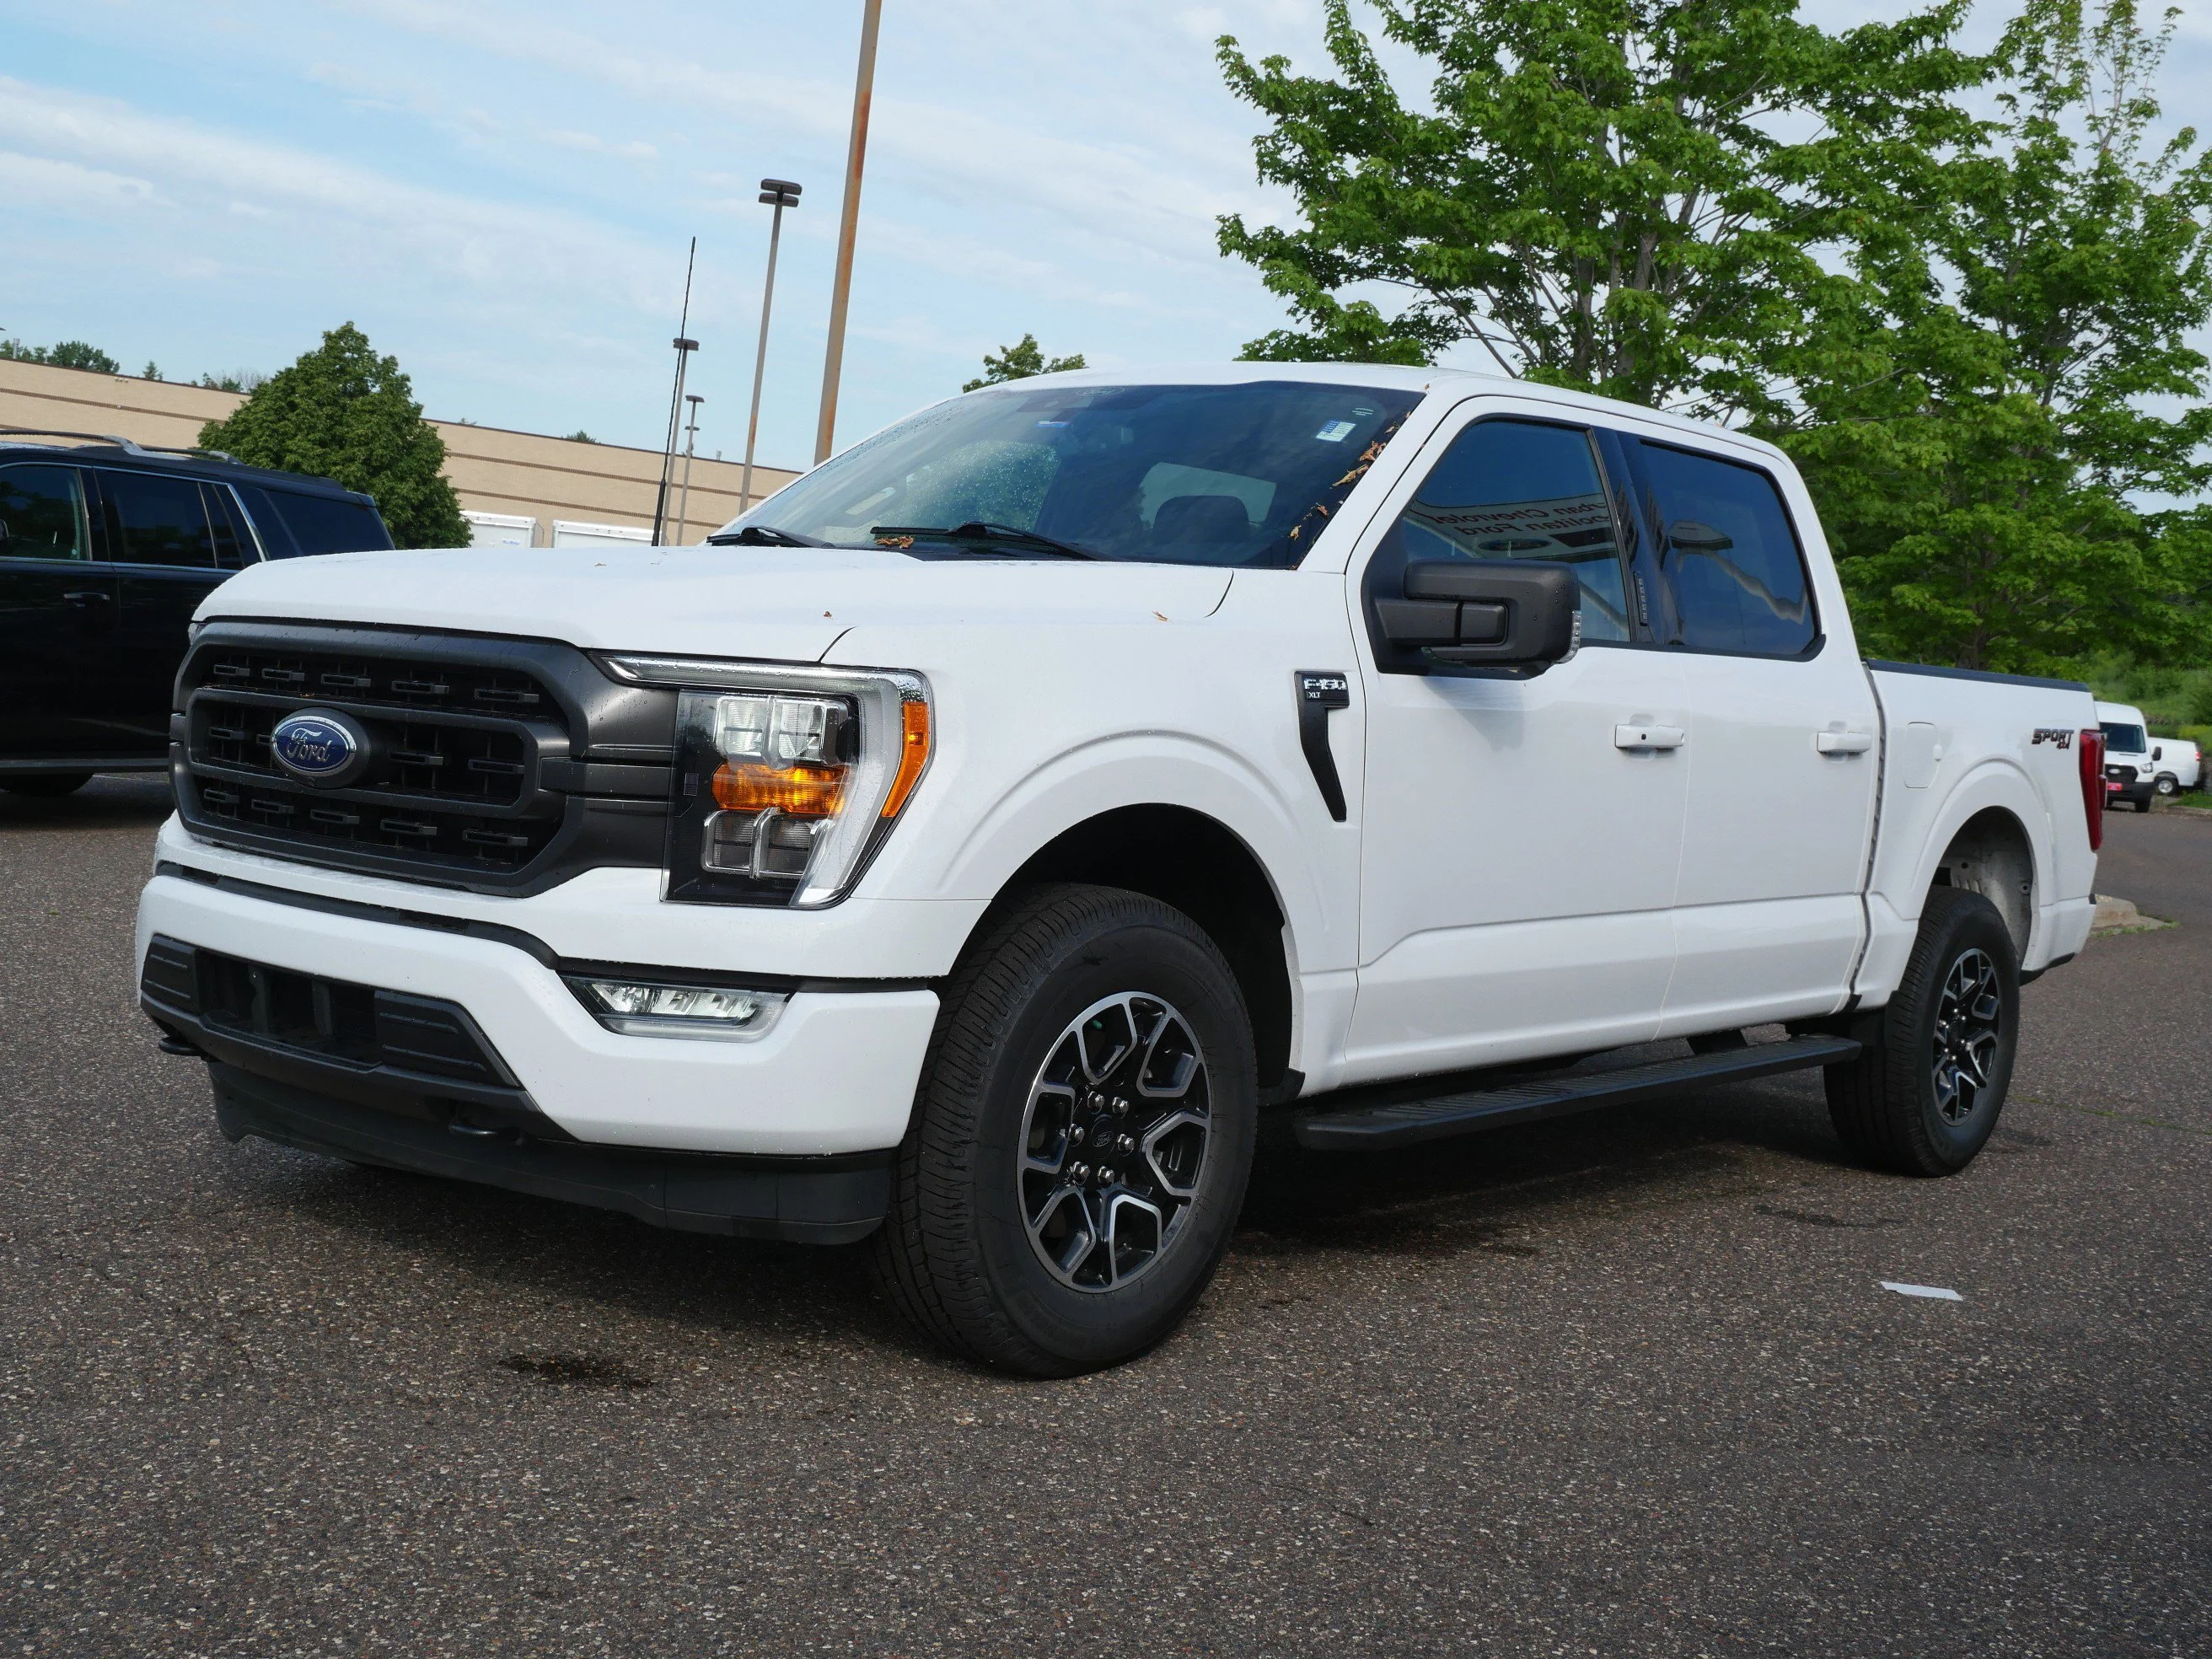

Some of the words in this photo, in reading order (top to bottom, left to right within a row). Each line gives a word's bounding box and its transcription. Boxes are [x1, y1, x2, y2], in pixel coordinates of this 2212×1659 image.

[1303, 678, 1347, 690] F-150
[287, 727, 333, 762] Ford
[2031, 728, 2074, 745] SPORT
